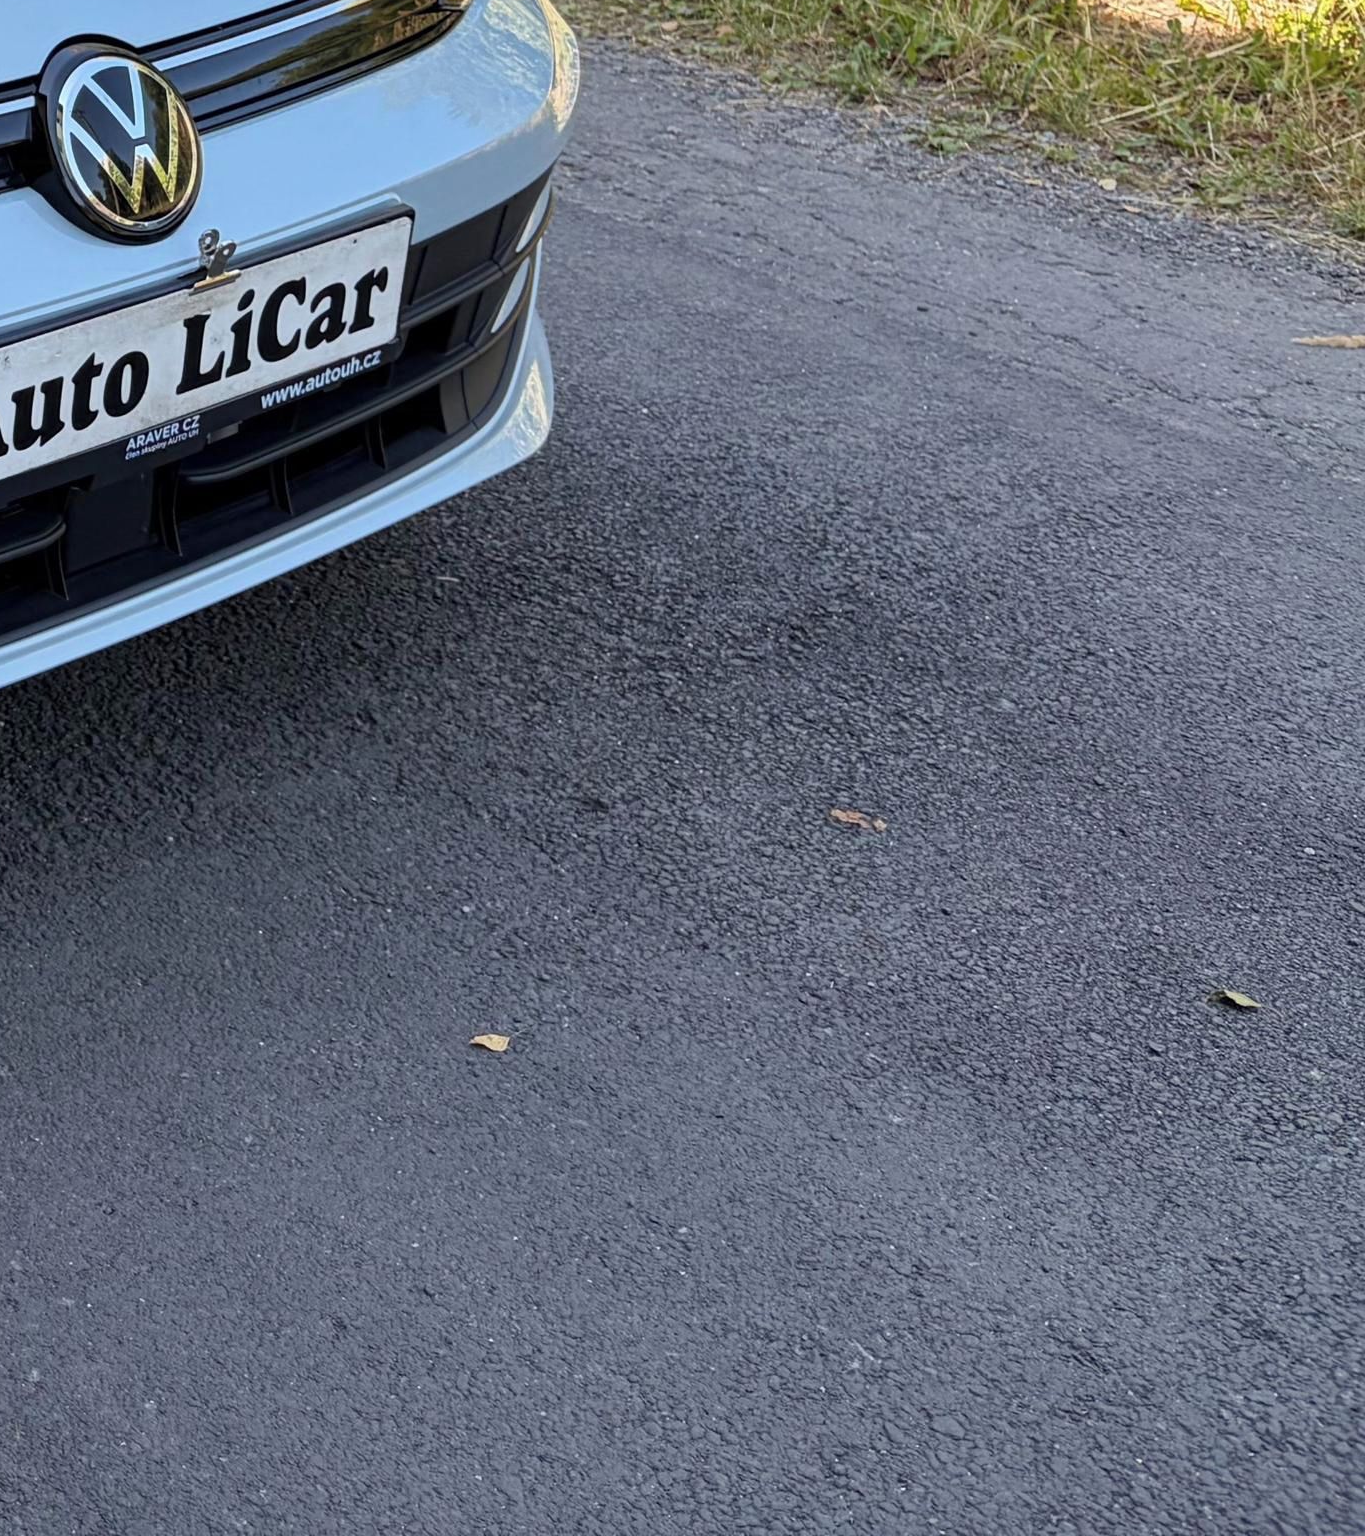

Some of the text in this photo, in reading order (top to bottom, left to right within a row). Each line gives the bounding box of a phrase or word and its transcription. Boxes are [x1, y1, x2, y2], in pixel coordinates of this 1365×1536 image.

[63, 58, 191, 220] VW
[176, 266, 389, 395] LiCar
[261, 350, 382, 409] www.autouh.cz
[126, 415, 200, 452] ARAVER CZ
[168, 432, 188, 445] AUTO
[189, 428, 199, 438] UH
